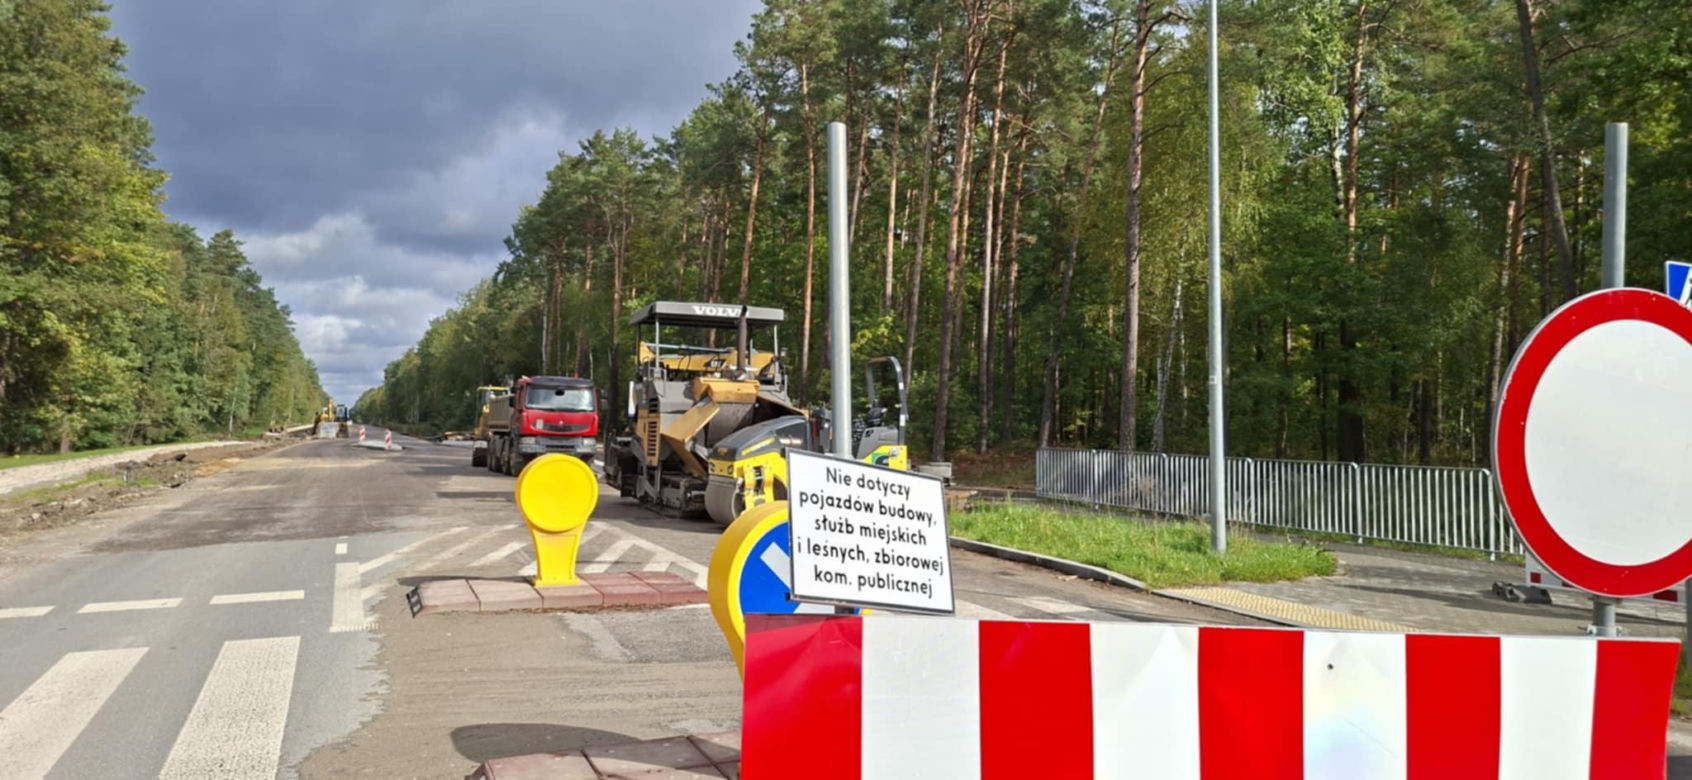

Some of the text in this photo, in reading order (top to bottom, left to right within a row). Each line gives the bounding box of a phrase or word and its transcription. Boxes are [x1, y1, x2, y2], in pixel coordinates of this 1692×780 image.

[826, 467, 911, 500] Nie dotyczy
[799, 489, 937, 527] pojazdów budowy,
[815, 515, 927, 546] służb miejskich
[797, 537, 944, 575] i leśnych, zbiorowej
[814, 565, 932, 598] kom. publicznej
